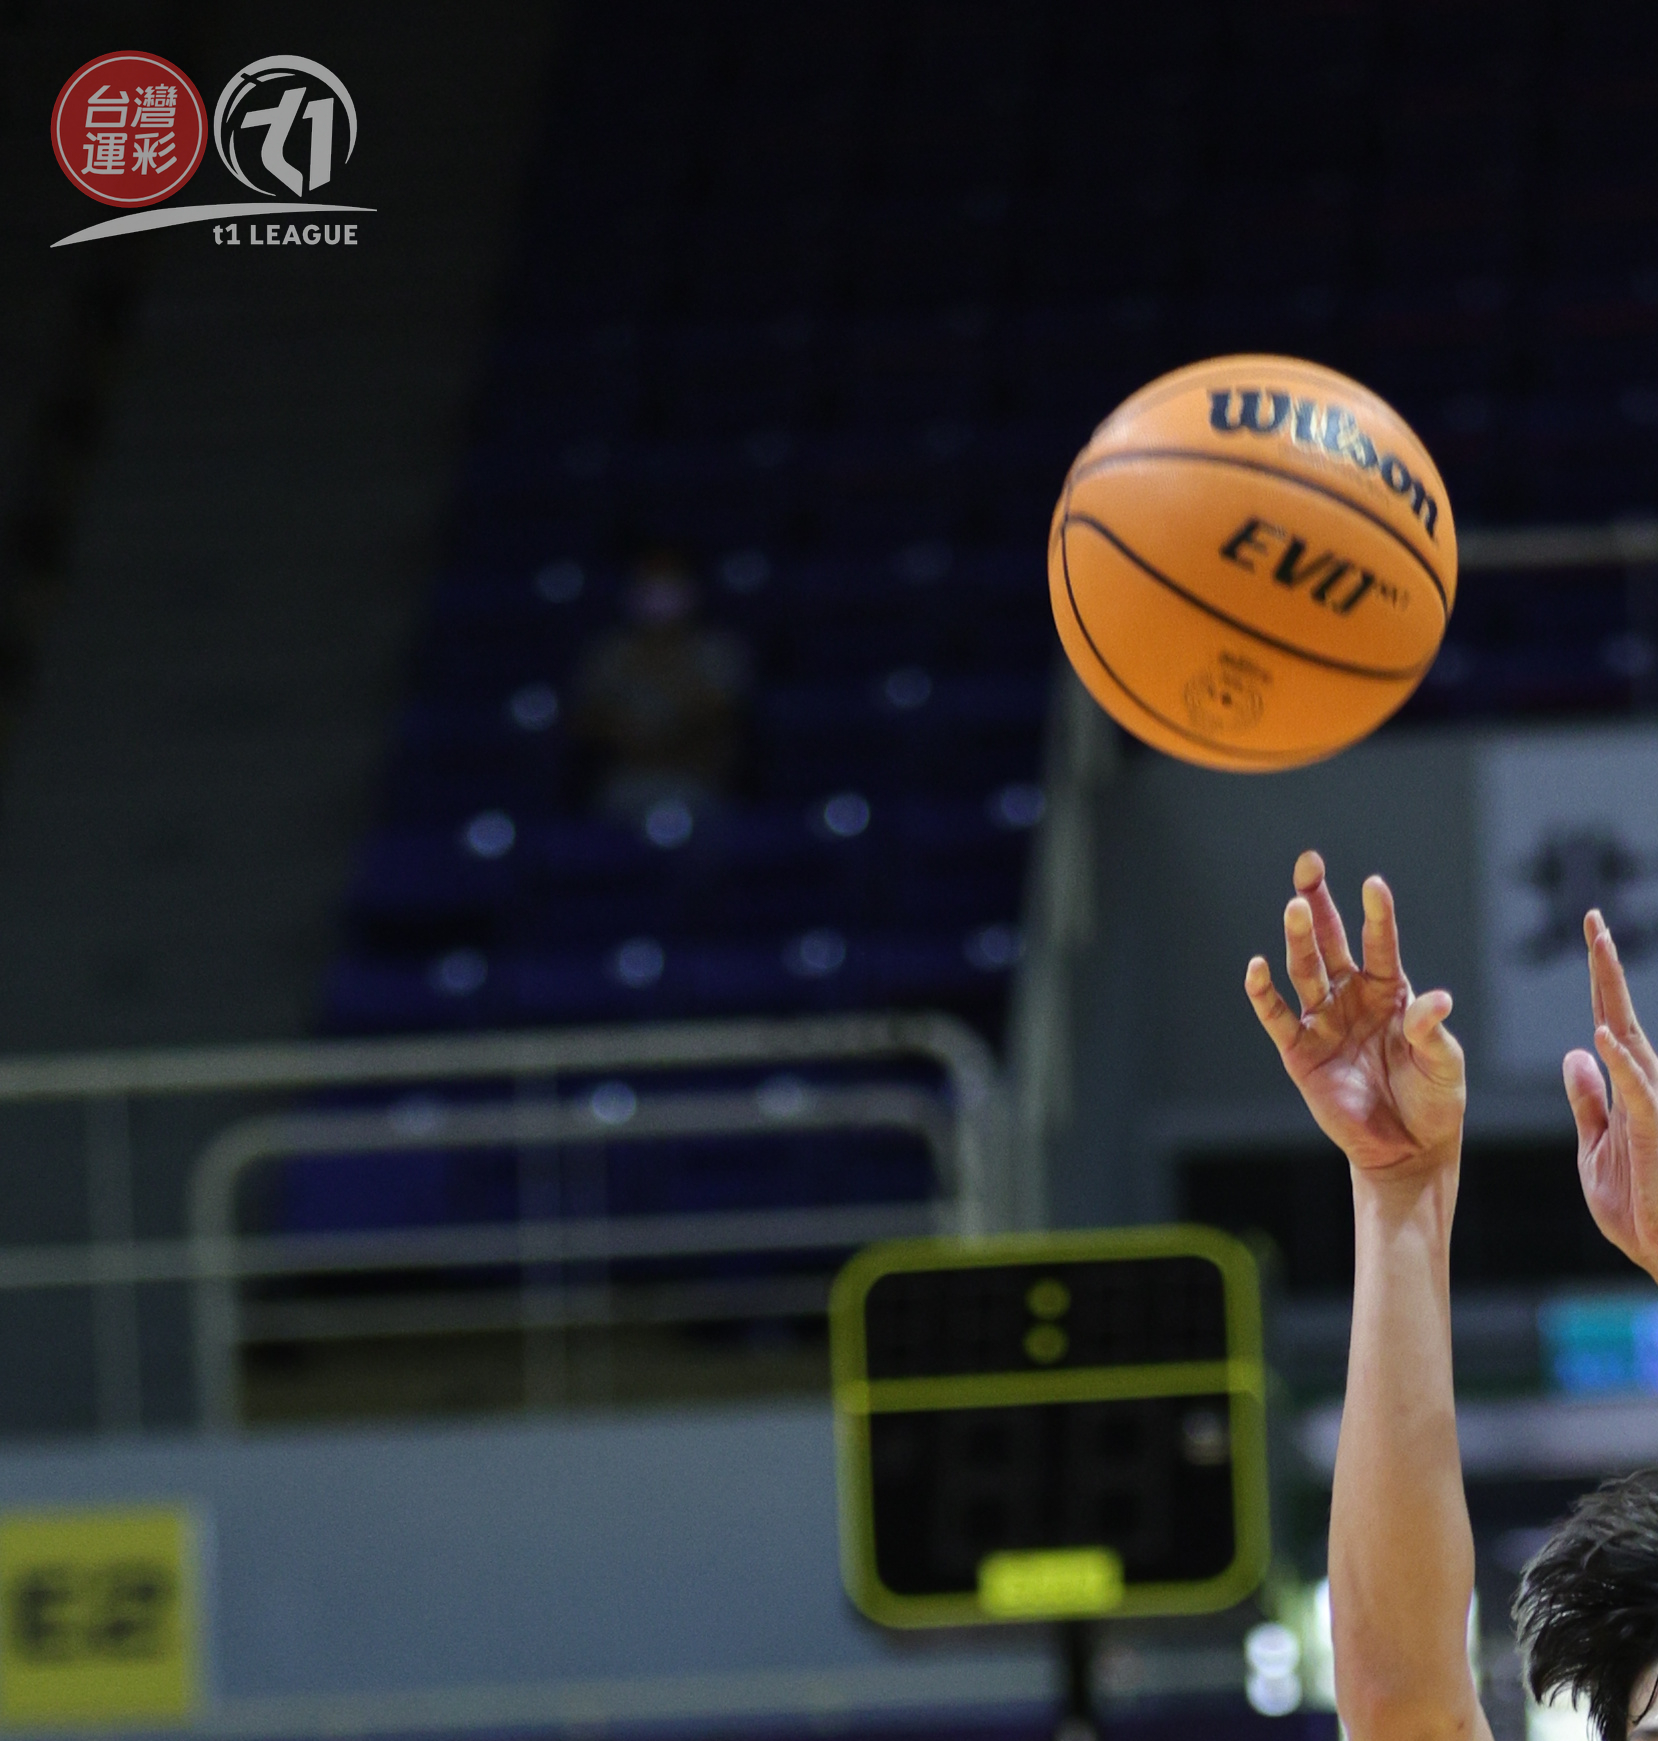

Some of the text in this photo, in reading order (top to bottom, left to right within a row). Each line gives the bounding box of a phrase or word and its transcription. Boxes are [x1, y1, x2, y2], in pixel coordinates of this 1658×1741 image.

[1210, 389, 1439, 542] Wilson
[1219, 516, 1377, 617] EVO
[10, 1557, 178, 1666] E2
